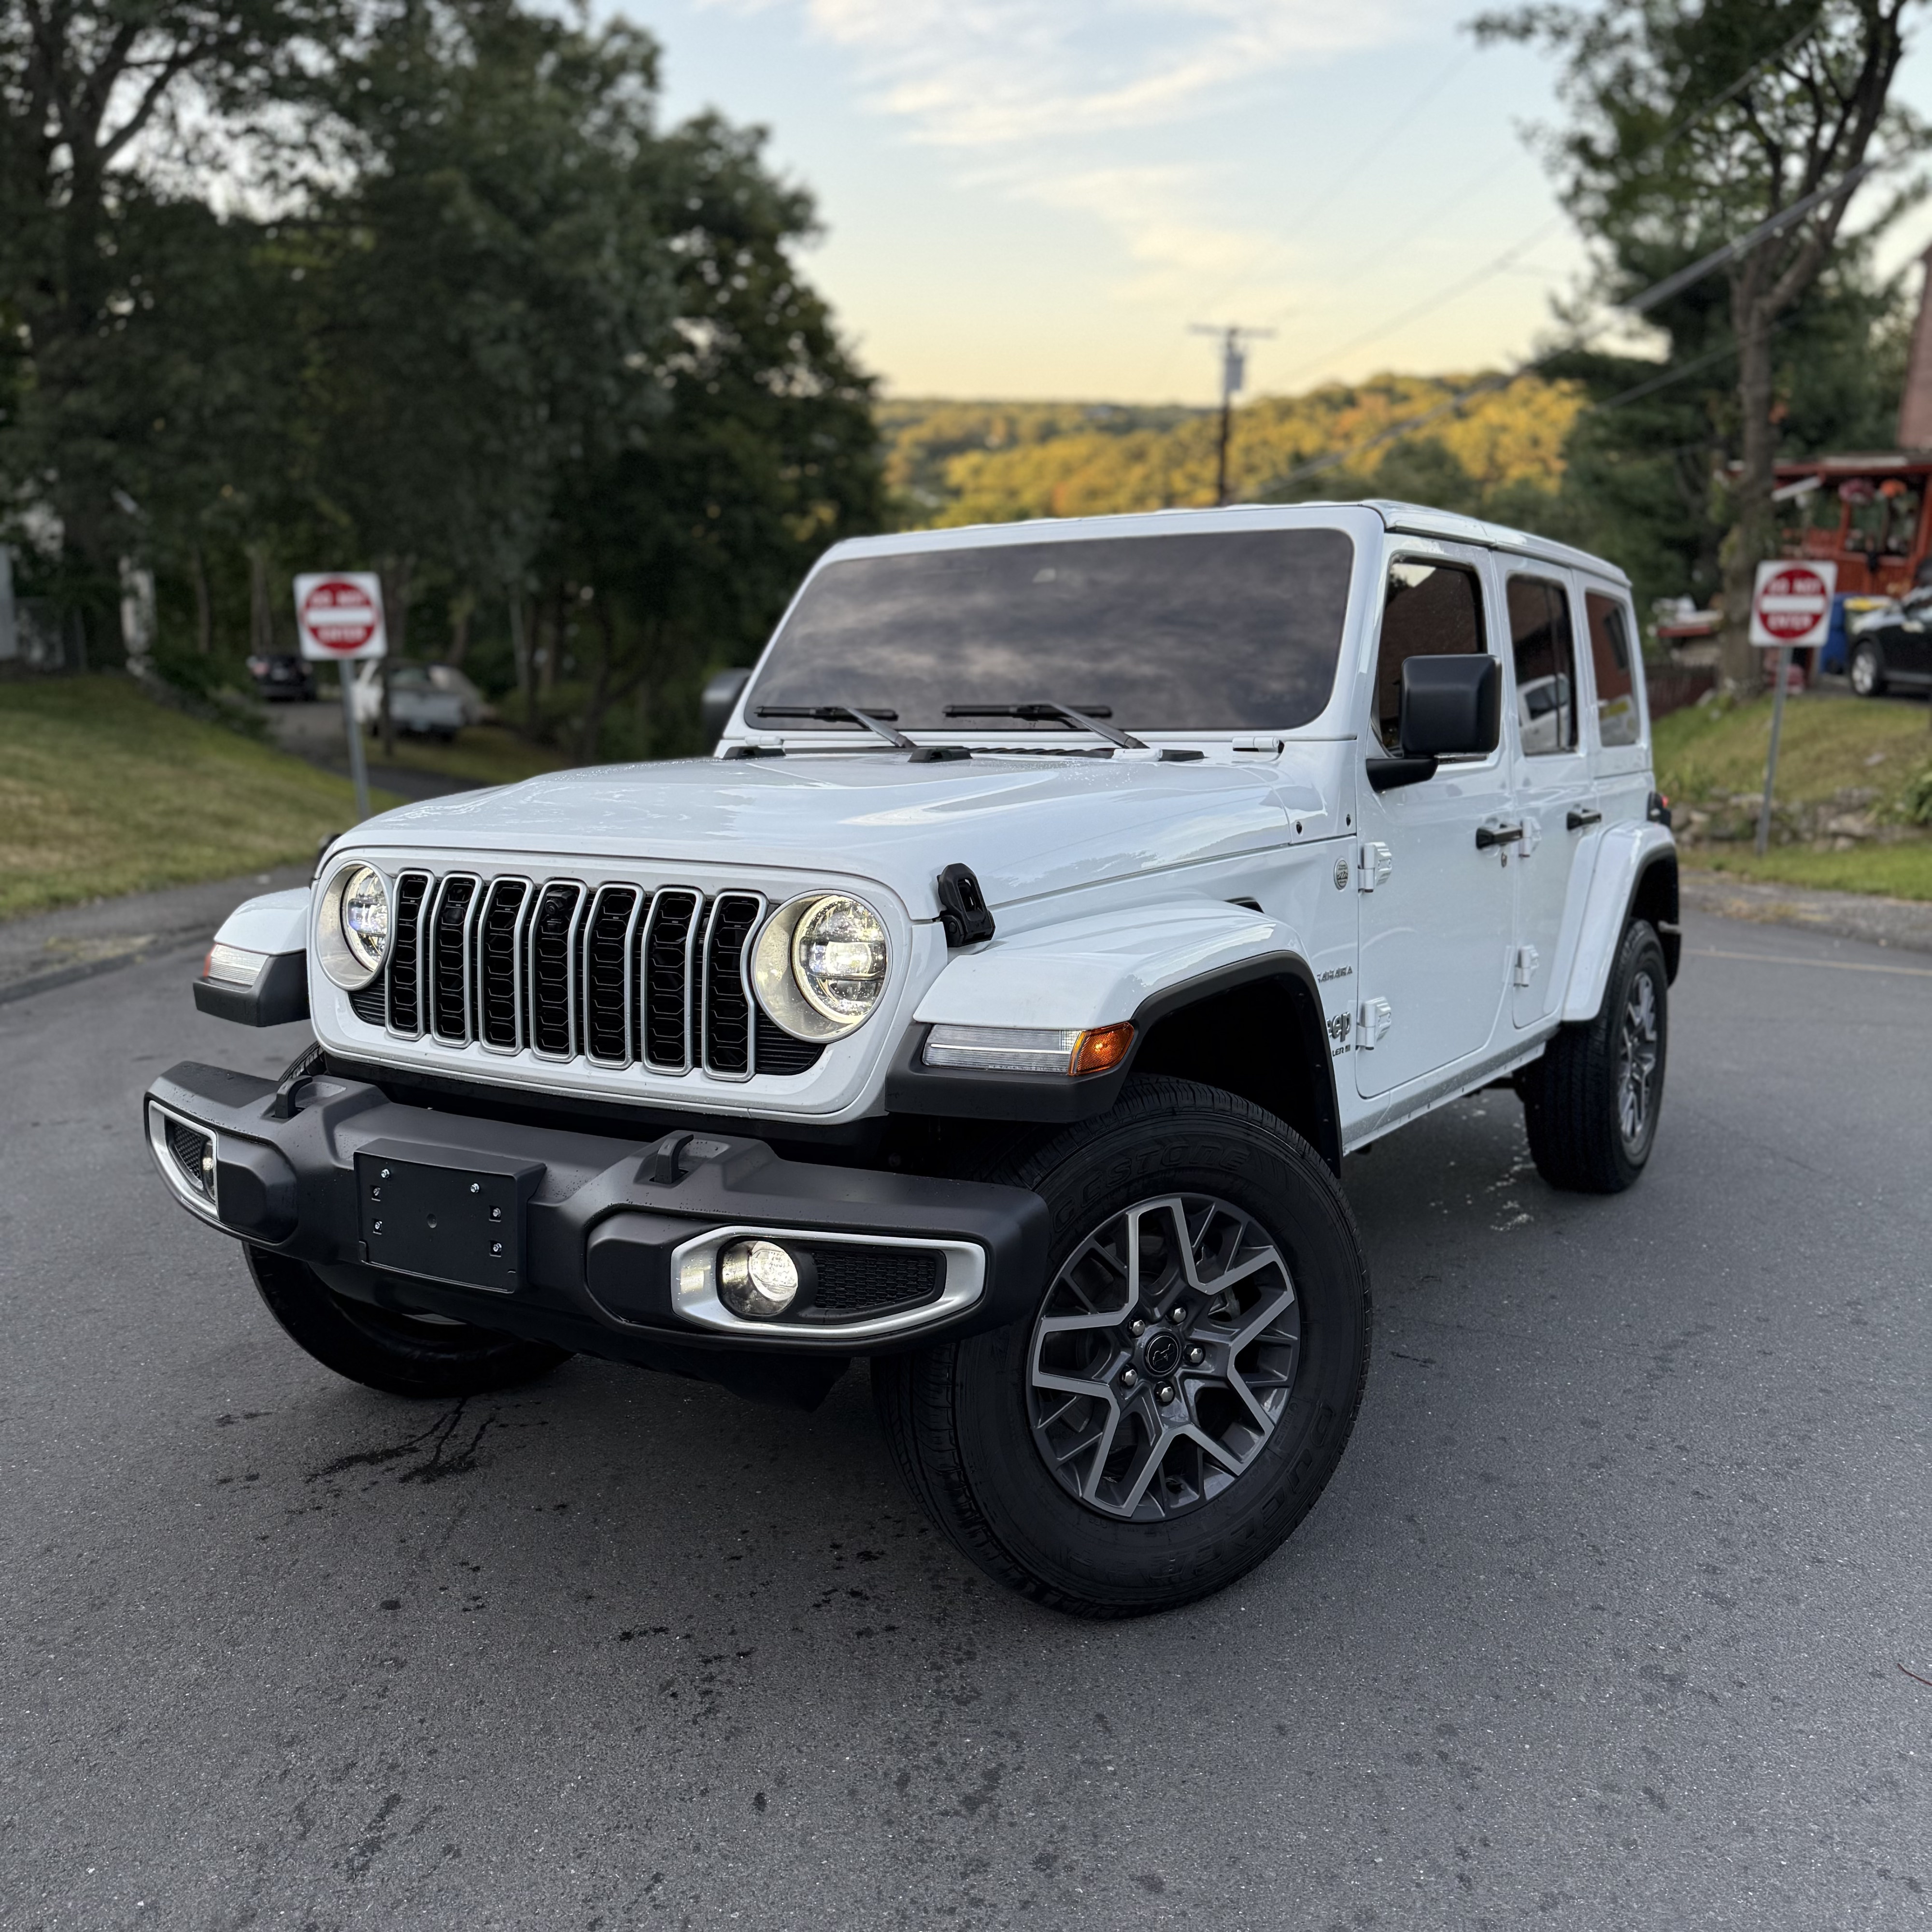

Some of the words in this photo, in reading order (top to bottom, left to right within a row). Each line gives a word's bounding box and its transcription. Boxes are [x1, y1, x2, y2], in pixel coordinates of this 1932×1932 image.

[1769, 578, 1789, 593] DO
[1326, 1011, 1351, 1042] eep
[1052, 1141, 1251, 1233] GESTONE
